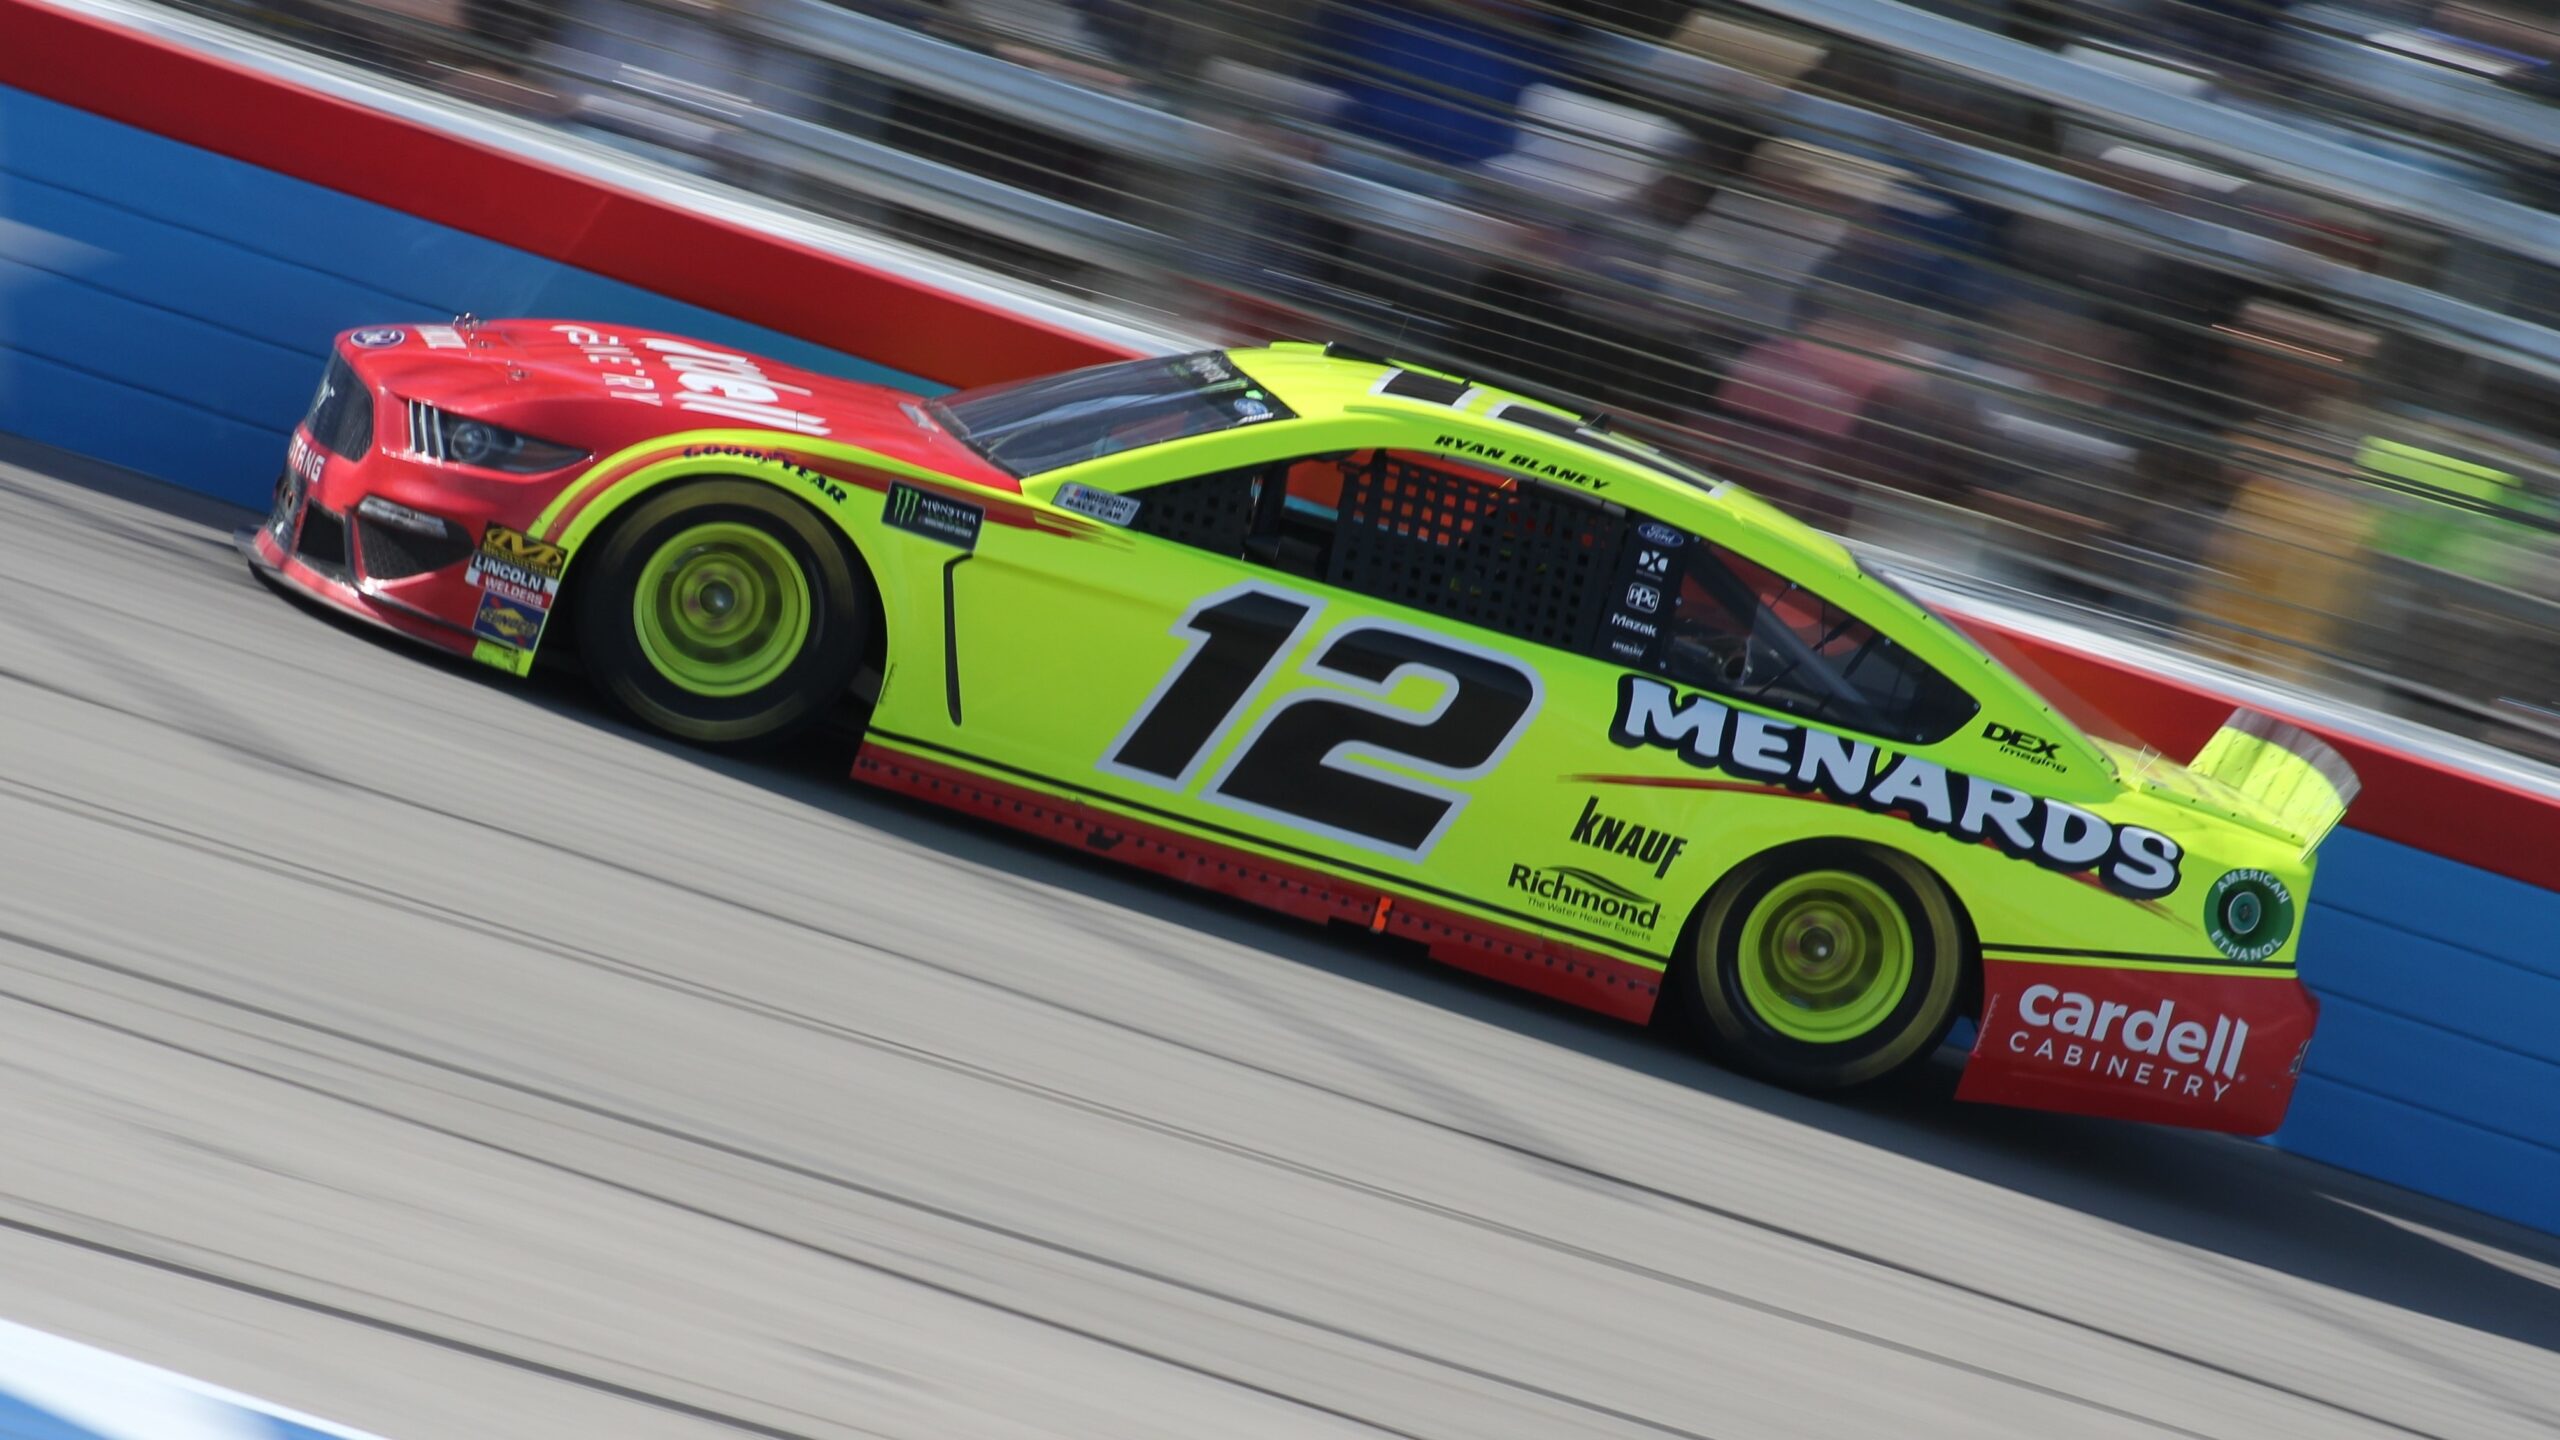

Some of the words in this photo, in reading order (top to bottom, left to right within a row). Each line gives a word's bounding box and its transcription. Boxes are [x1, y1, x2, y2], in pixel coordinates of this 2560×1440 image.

[1434, 434, 1504, 460] RYAN
[1509, 455, 1610, 490] BLANEY
[922, 498, 977, 525] MONSTER
[1066, 498, 1095, 516] RACE
[1104, 507, 1122, 521] CAR
[1084, 489, 1128, 512] NASCAR
[475, 554, 542, 591] LINCOLN
[485, 576, 544, 607] WELDERS
[1629, 588, 1657, 608] PPG
[1612, 613, 1657, 638] Mazak
[1095, 579, 1546, 865] 12
[1982, 721, 2061, 759] DEX
[1608, 674, 2184, 898] MENARDS
[1507, 863, 1662, 930] Richmond
[2217, 869, 2290, 904] AMERICAN
[1528, 897, 1545, 910] The
[1547, 901, 1576, 919] Water
[1579, 912, 1613, 930] Heater
[1614, 921, 1652, 942] Experts
[2211, 929, 2283, 961] ETHANOL
[2018, 983, 2249, 1080] cardell
[2009, 1030, 2231, 1102] CABINETRY
